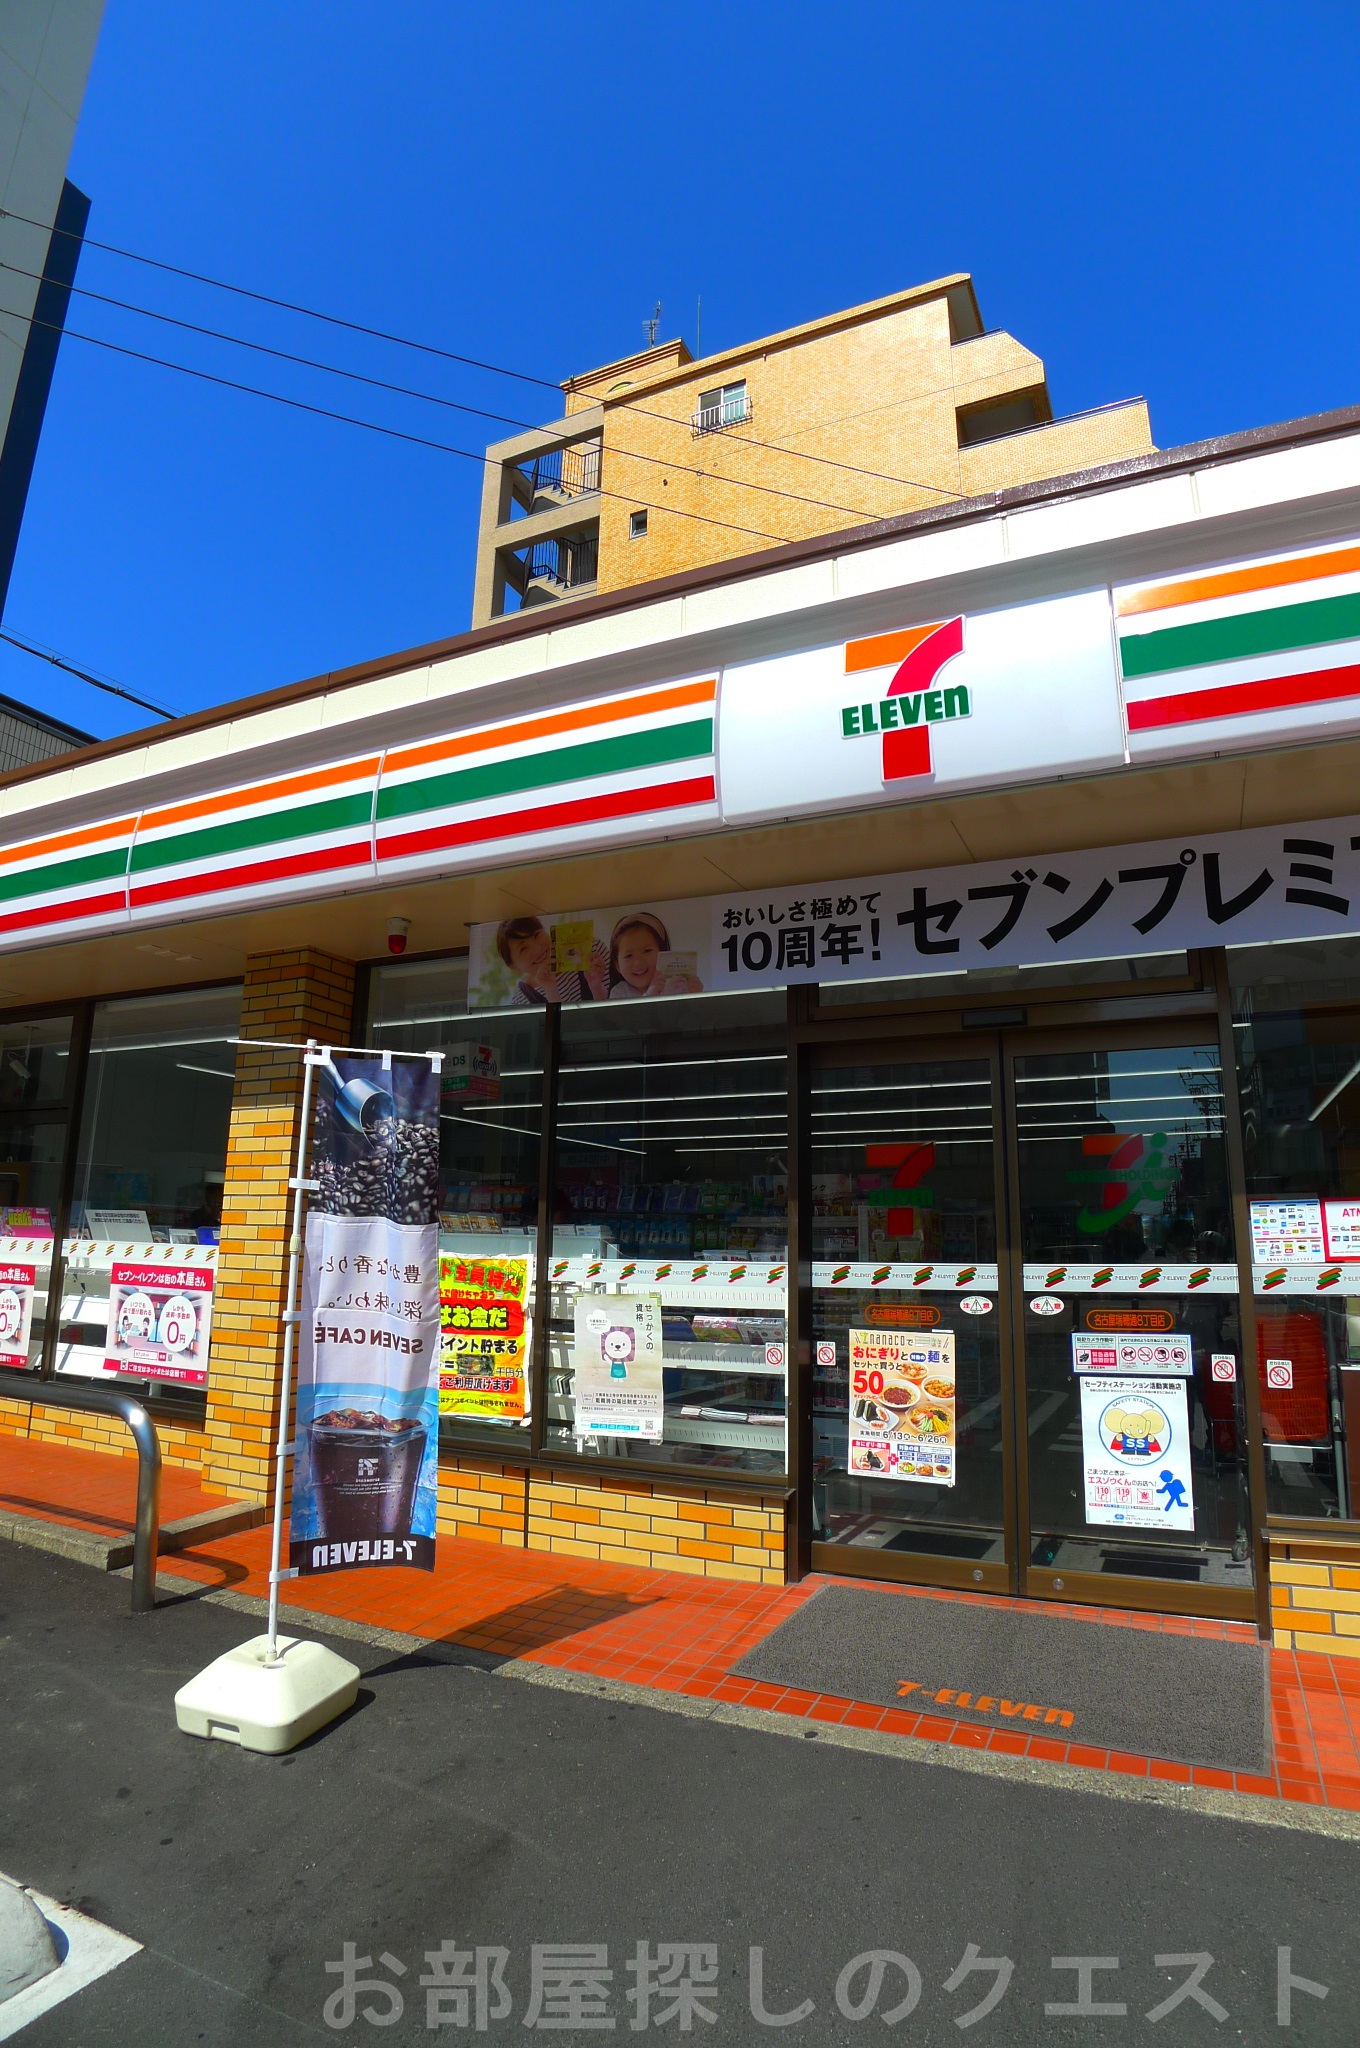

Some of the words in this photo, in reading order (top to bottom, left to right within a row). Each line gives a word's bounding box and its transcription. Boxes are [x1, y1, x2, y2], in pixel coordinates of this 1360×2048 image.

[722, 891, 882, 929] おいしさ極めて
[897, 836, 1360, 956] セブンプレミ
[721, 917, 882, 973] 10周年!
[853, 1370, 884, 1395] 50
